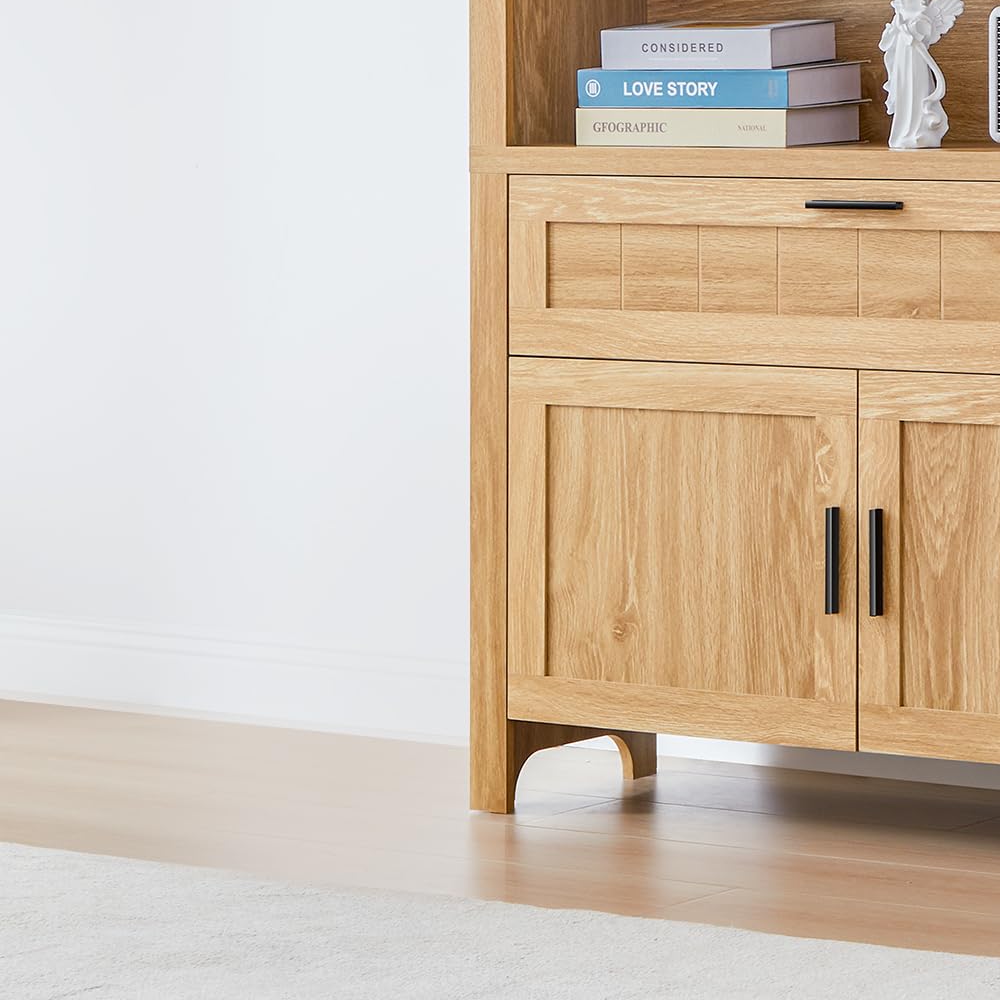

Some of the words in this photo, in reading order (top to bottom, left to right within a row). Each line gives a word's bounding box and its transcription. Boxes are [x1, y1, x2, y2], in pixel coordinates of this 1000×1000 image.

[641, 42, 724, 53] CONSIDERED
[623, 81, 663, 97] LOVE
[667, 81, 718, 97] STORY
[592, 121, 668, 134] GFOGRAPHIC
[737, 123, 767, 132] NATIONAL
